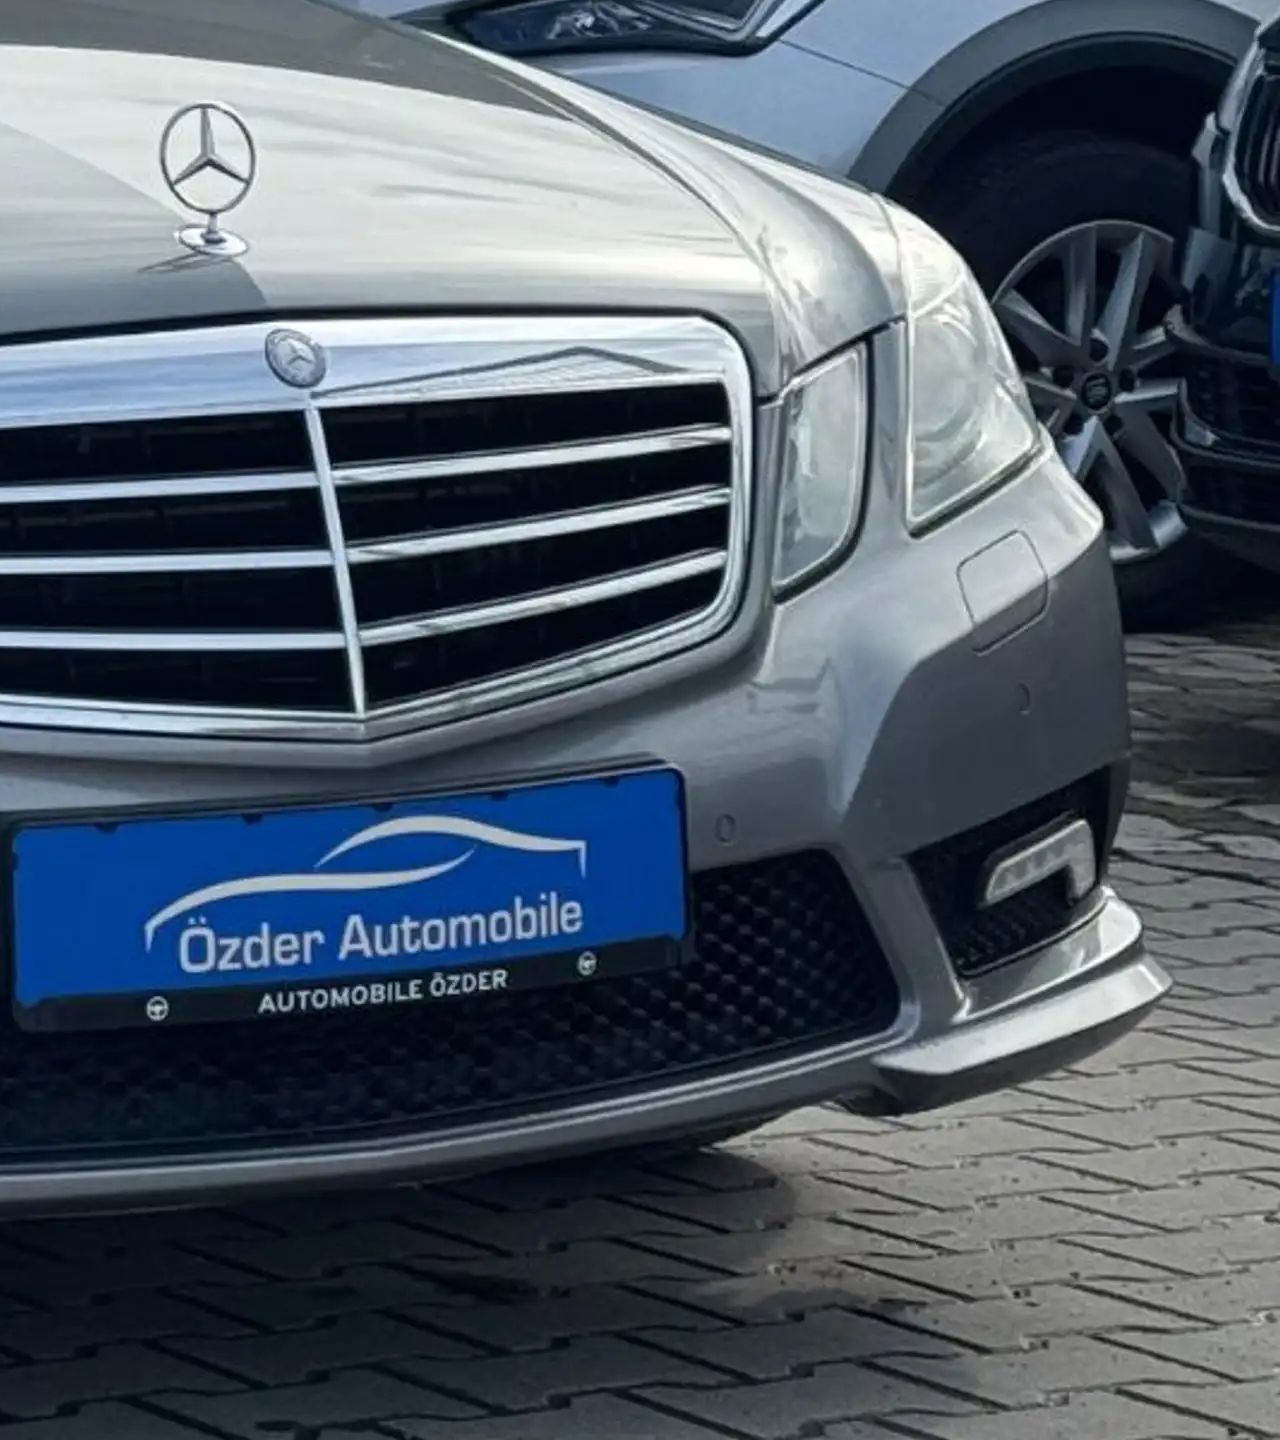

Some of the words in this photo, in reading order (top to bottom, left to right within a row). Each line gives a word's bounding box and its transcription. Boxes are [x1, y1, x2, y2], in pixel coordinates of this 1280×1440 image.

[180, 915, 325, 973] Özder
[338, 891, 584, 960] Automobile
[258, 972, 422, 1014] AUTOMOBILE
[429, 969, 508, 999] ÖZDER
